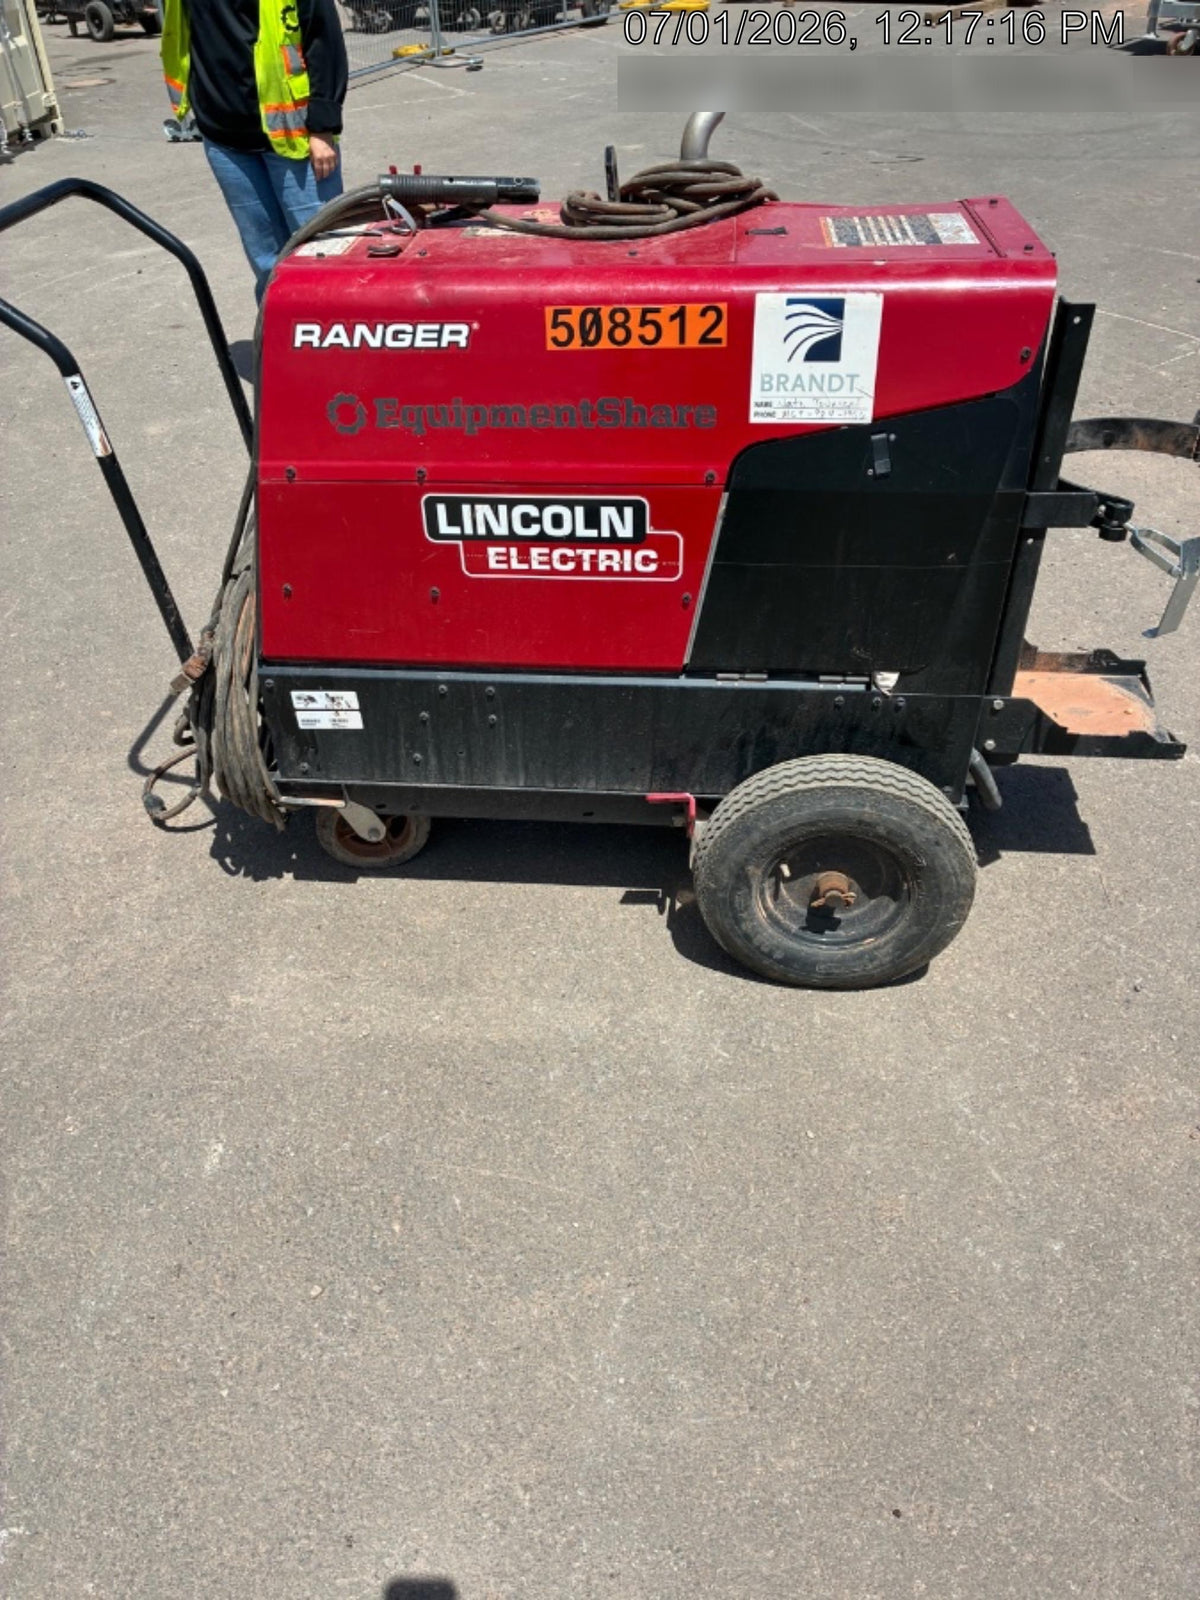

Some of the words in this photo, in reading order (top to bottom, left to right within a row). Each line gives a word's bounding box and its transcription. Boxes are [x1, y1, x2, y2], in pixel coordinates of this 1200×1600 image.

[293, 322, 470, 348] RANGER
[550, 305, 724, 347] 508512
[760, 373, 860, 393] BRANDT
[373, 396, 717, 436] EquipmentShare
[436, 502, 634, 538] LINCOLN
[486, 547, 658, 572] ELECTRIC
